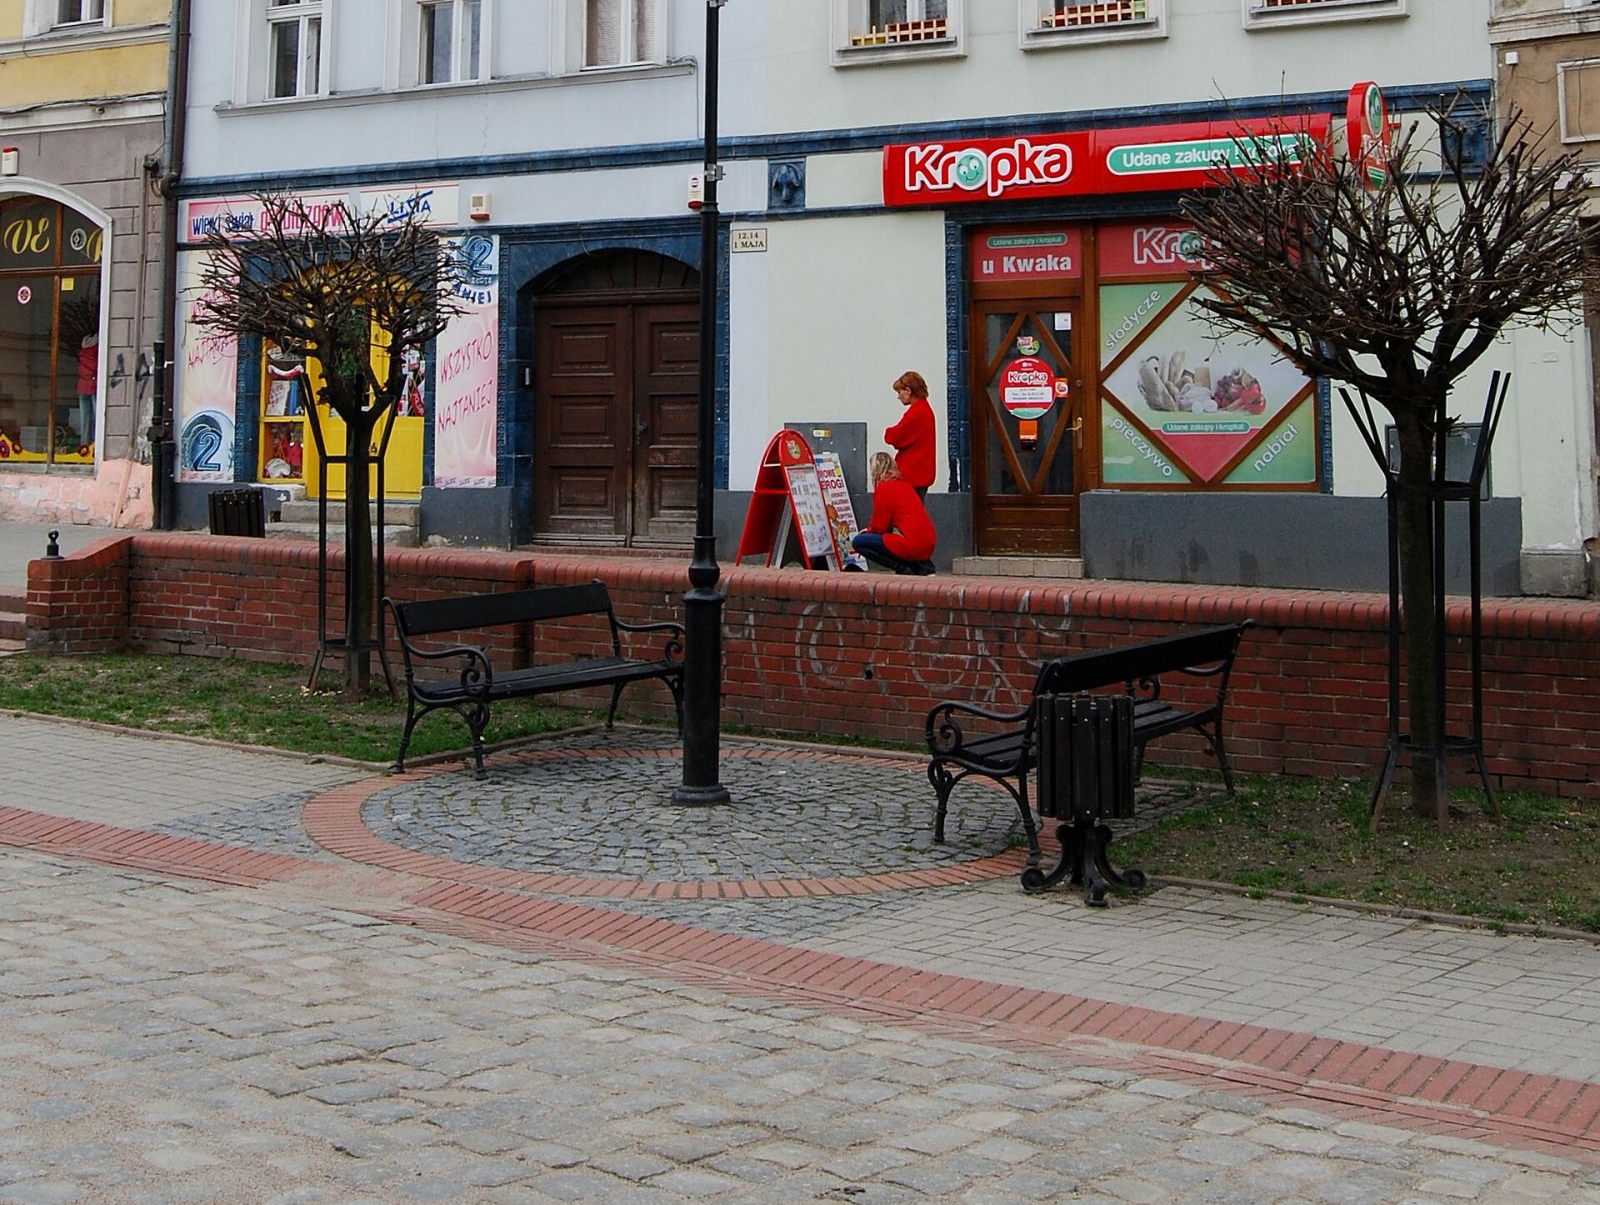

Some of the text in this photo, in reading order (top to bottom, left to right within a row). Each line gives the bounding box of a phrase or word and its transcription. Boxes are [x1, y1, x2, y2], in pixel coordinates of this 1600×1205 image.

[906, 140, 1071, 195] Kropka
[1122, 150, 1171, 168] Udane
[1174, 146, 1230, 164] zakupy
[740, 240, 764, 248] MAJA
[982, 254, 1072, 274] u Kwaka
[1105, 289, 1161, 350] słodycze
[440, 331, 492, 384] WSZYSTKO
[1008, 370, 1047, 384] Kropka
[438, 379, 494, 434] NAJTANIEJ
[1166, 423, 1188, 431] Udane
[1190, 423, 1215, 433] zakupy
[193, 428, 222, 471] 2
[1111, 418, 1173, 477] pieczywo
[1254, 422, 1298, 472] nabiał
